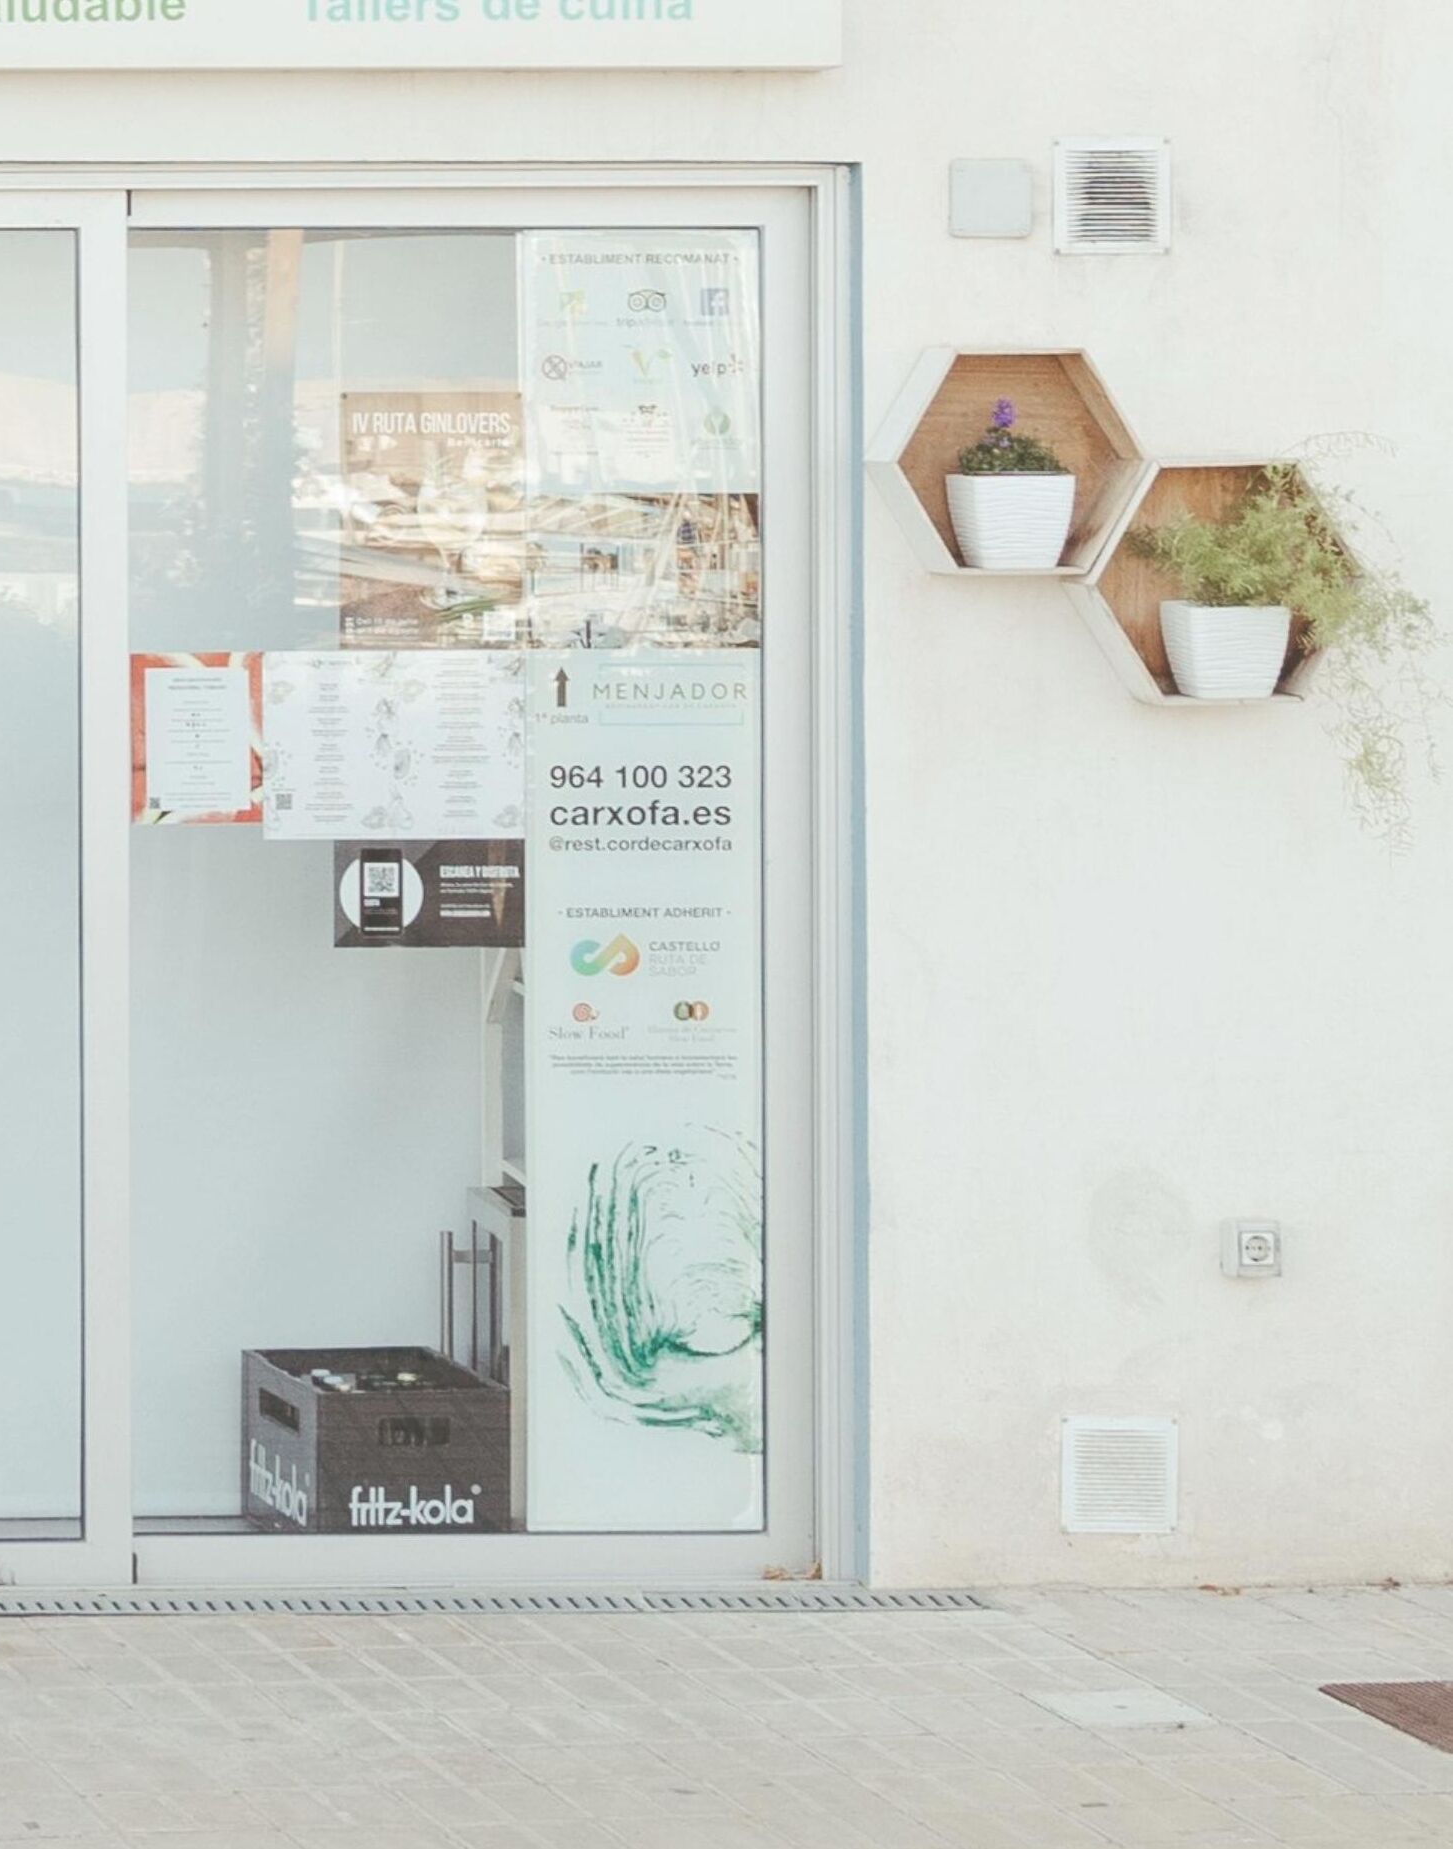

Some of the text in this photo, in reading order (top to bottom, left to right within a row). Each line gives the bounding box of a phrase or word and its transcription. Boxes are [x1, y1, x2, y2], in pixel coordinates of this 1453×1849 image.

[306, 0, 693, 22] Tallers de cuina
[549, 253, 730, 265] ESTABLIMENT RECOMANAT
[353, 411, 511, 435] IV RUTA GINLOVERS
[593, 683, 747, 700] MENJADOR
[550, 712, 589, 725] planta
[550, 765, 732, 788] 964 100 323
[550, 800, 732, 826] carxofa.es
[549, 836, 733, 852] @rest.cordecarxofa
[566, 907, 724, 918] ESTABLIMENT ADHERIT
[649, 953, 708, 965] RUTA DE
[649, 967, 697, 978] SABOR
[549, 1026, 582, 1040] Slow
[348, 1484, 474, 1527] fritz-kola
